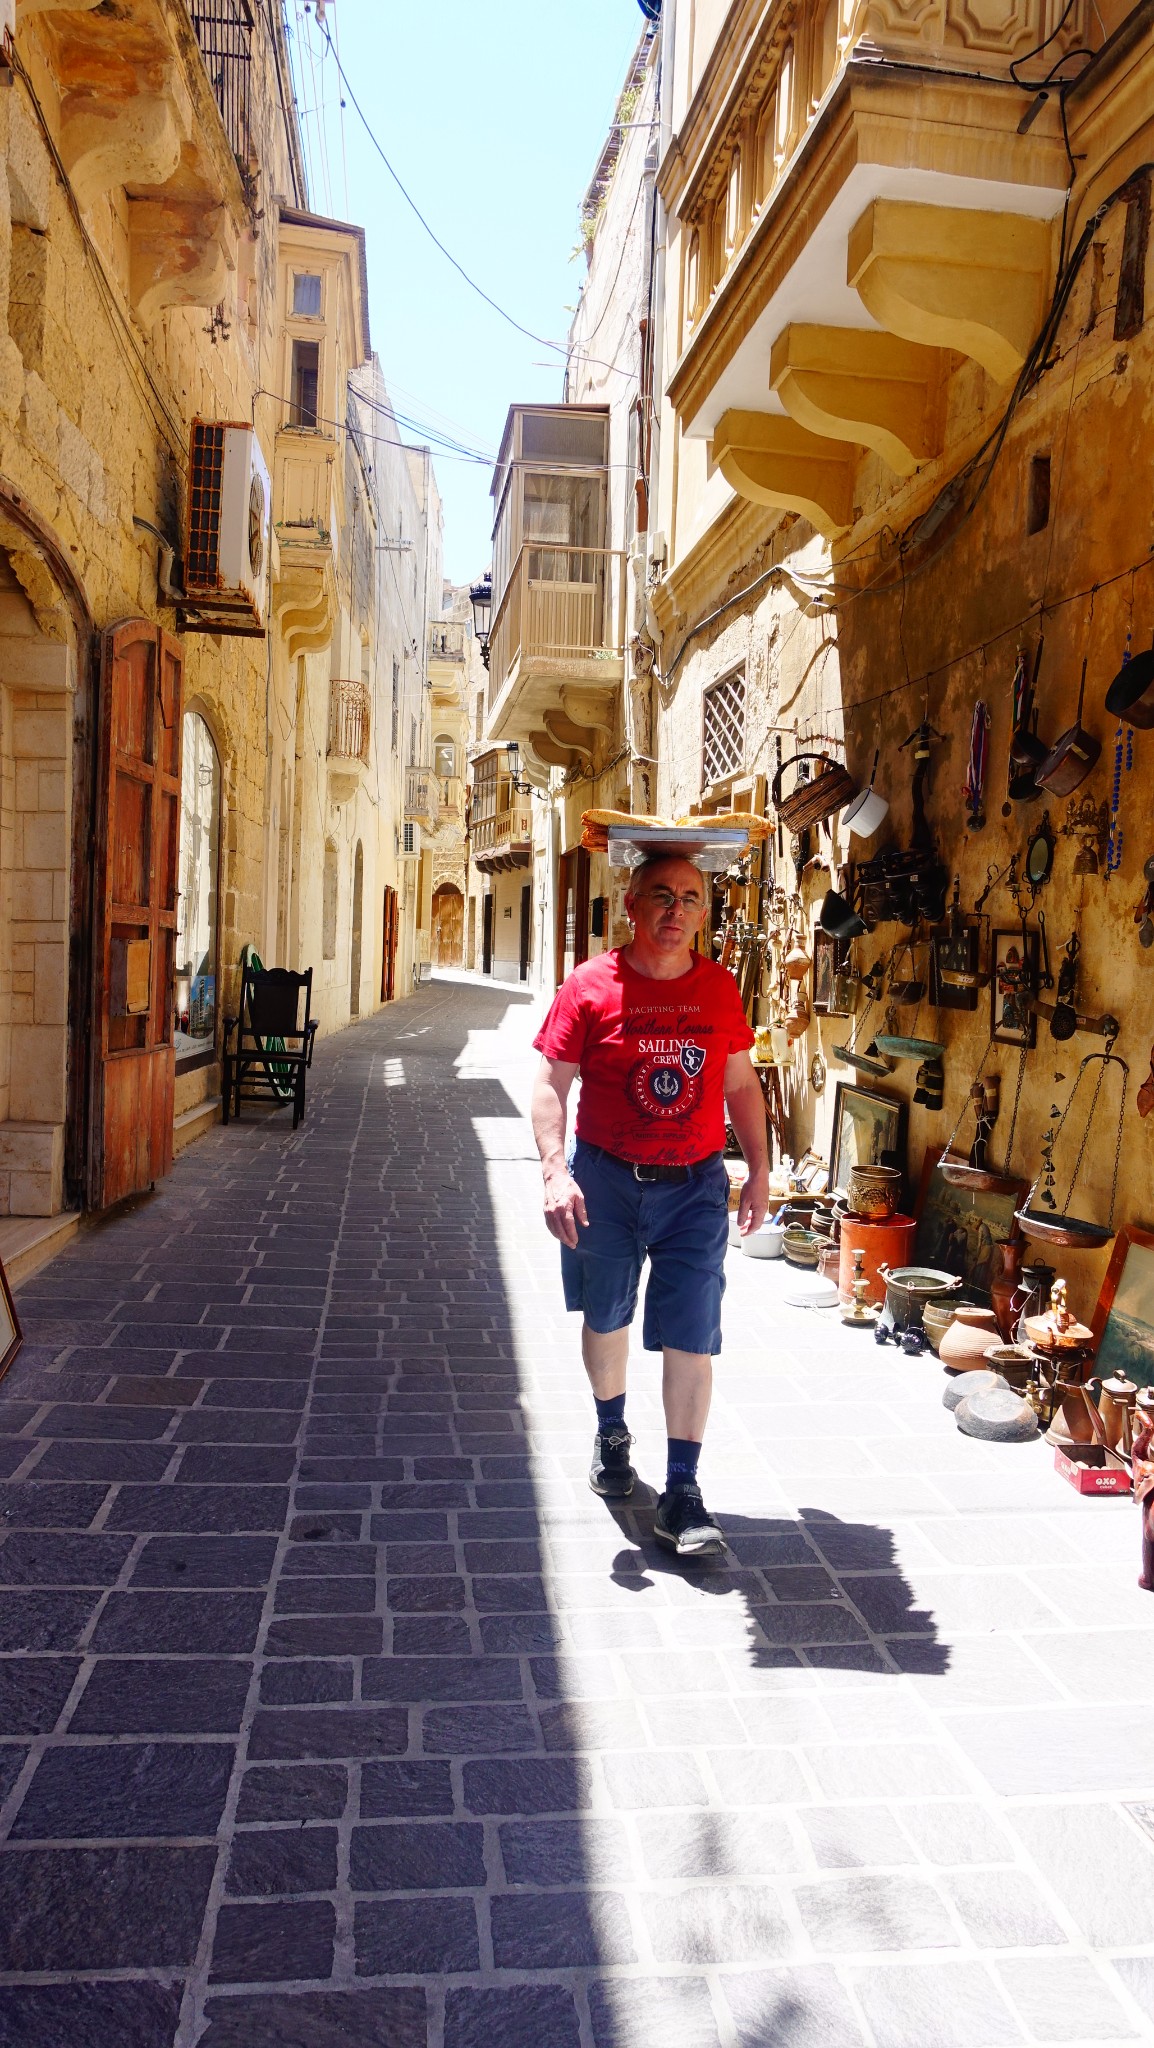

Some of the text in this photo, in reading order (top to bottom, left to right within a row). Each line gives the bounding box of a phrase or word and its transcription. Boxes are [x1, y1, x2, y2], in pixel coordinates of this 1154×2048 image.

[629, 1005, 701, 1015] YACHTING TEAM
[618, 1014, 714, 1036] Northern Course
[653, 1055, 680, 1065] CREW
[637, 1064, 686, 1115] INTERNATIONAL
